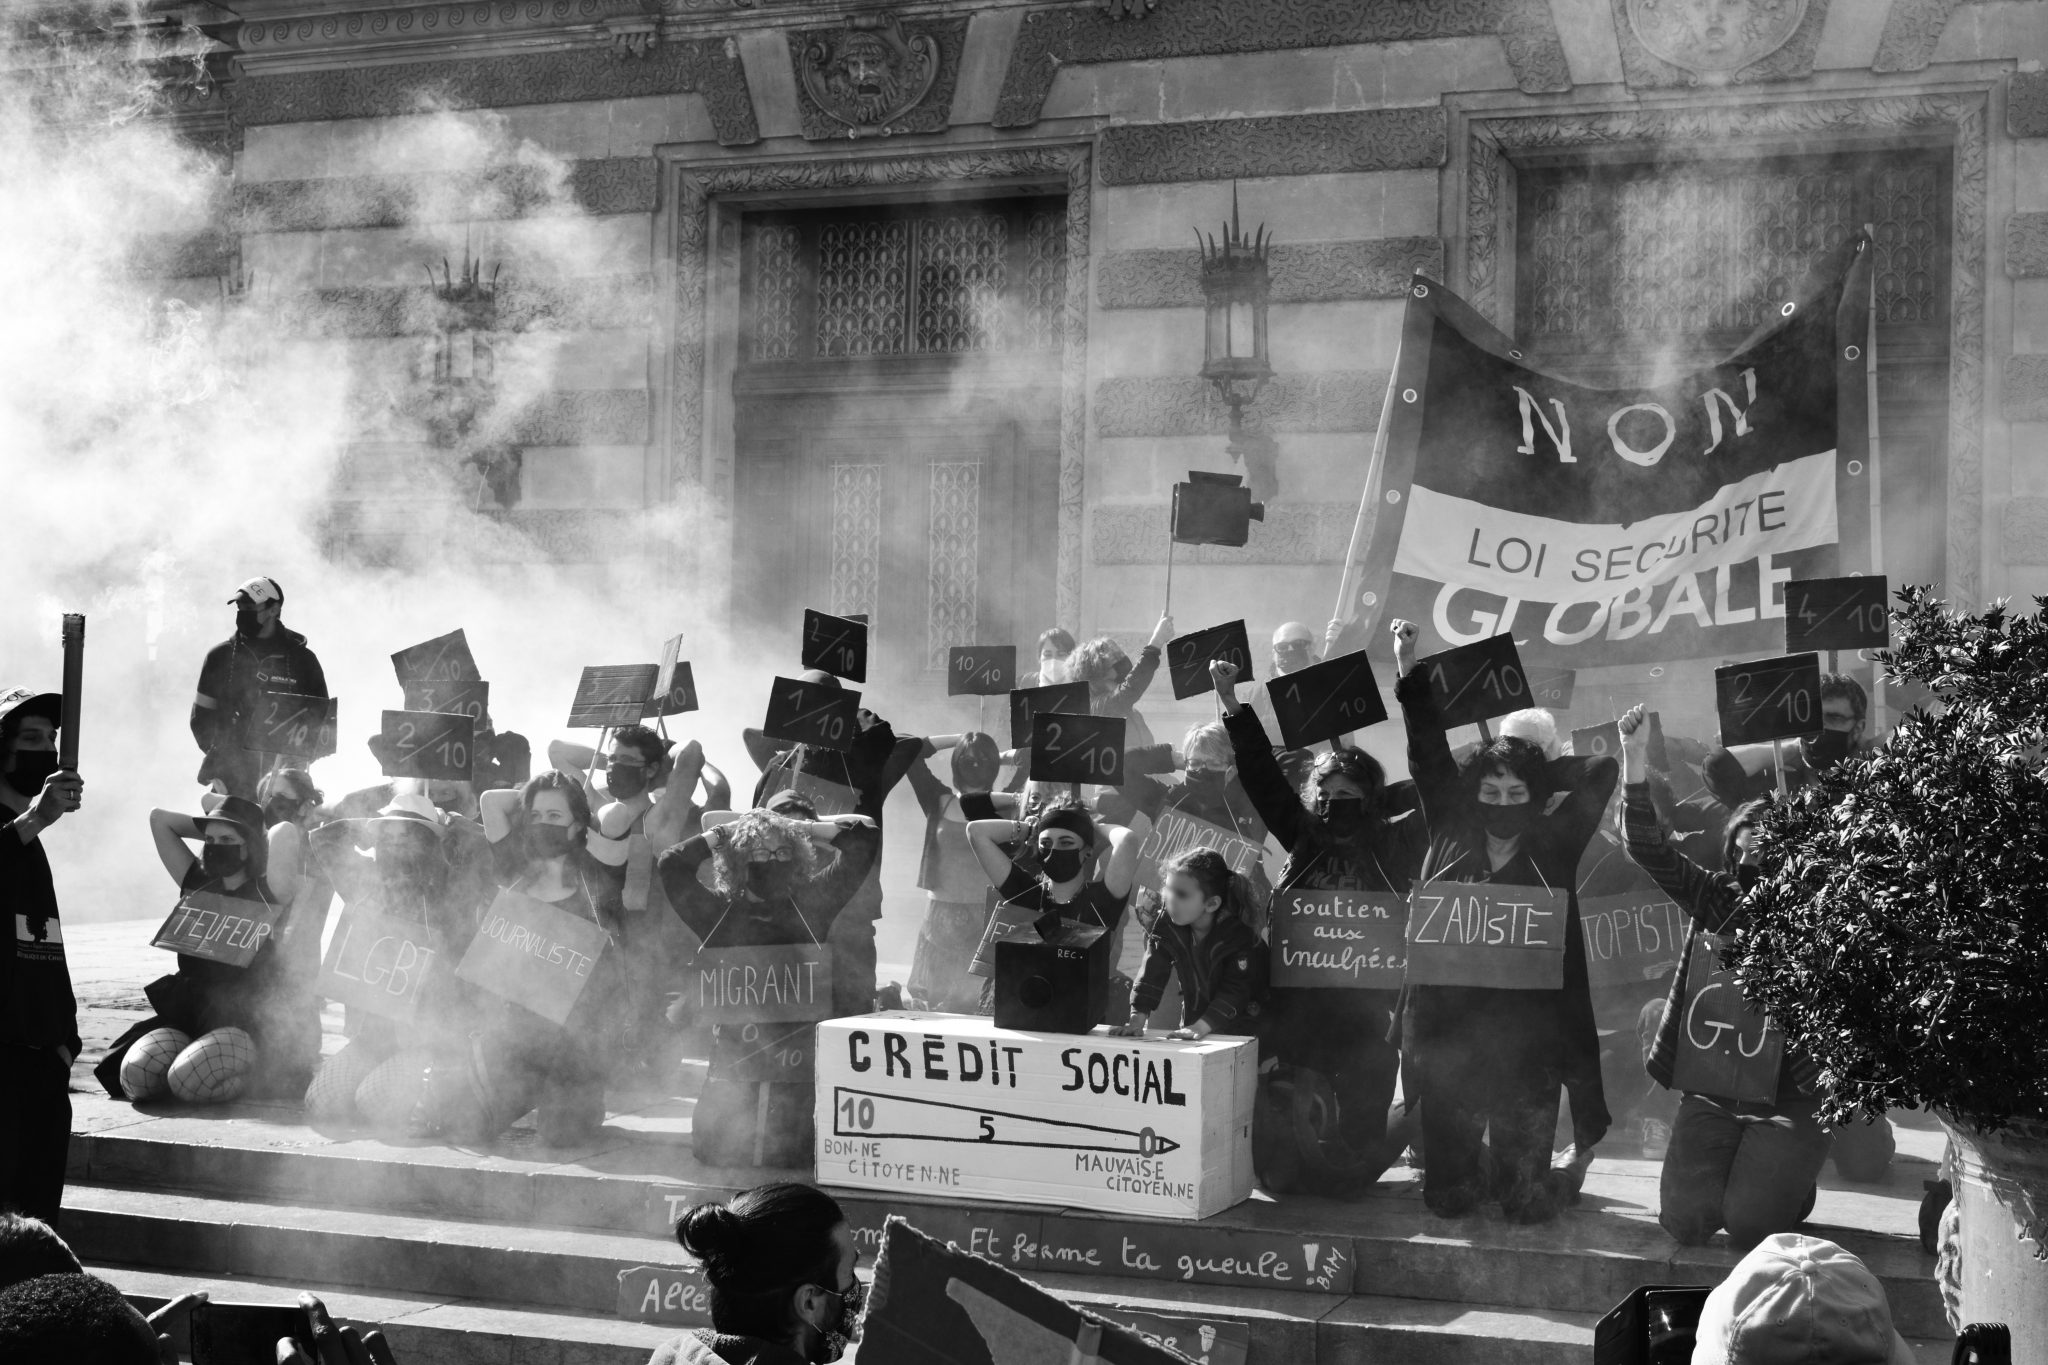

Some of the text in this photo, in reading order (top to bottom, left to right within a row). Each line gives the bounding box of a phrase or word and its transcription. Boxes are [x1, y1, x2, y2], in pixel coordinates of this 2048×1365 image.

[1512, 367, 1757, 467] NON
[1467, 527, 1547, 579] LOI
[1432, 553, 1793, 648] GLOBALE
[1797, 588, 1887, 638] 4/10
[809, 616, 855, 673] 2/10
[955, 655, 1001, 687] 10/10
[1285, 664, 1367, 736] 1/10
[1429, 658, 1524, 712] 1/10
[1530, 673, 1570, 701] /10
[1733, 671, 1811, 726] 2/10
[264, 701, 309, 747] 2/10
[782, 688, 844, 742] 1/10
[396, 721, 468, 770] 2/10
[1045, 722, 1118, 777] 2/10
[173, 905, 272, 952] TEUFEUR
[481, 914, 593, 977] JOURNALISTE
[1313, 925, 1367, 941] aux
[1414, 896, 1553, 945] ZADISTE
[334, 923, 437, 1005] LGBT
[1057, 948, 1083, 960] REC.
[699, 959, 820, 1008] MIGRANT
[727, 1022, 811, 1069] 0/10
[1061, 1048, 1187, 1107] SOCIAL
[840, 1097, 1157, 1159] 10 5 0
[969, 1227, 1003, 1259] Et
[1011, 1232, 1103, 1267] ferme
[1121, 1236, 1162, 1271] ta
[1177, 1250, 1293, 1282] gueule
[1316, 1246, 1347, 1291] BAM
